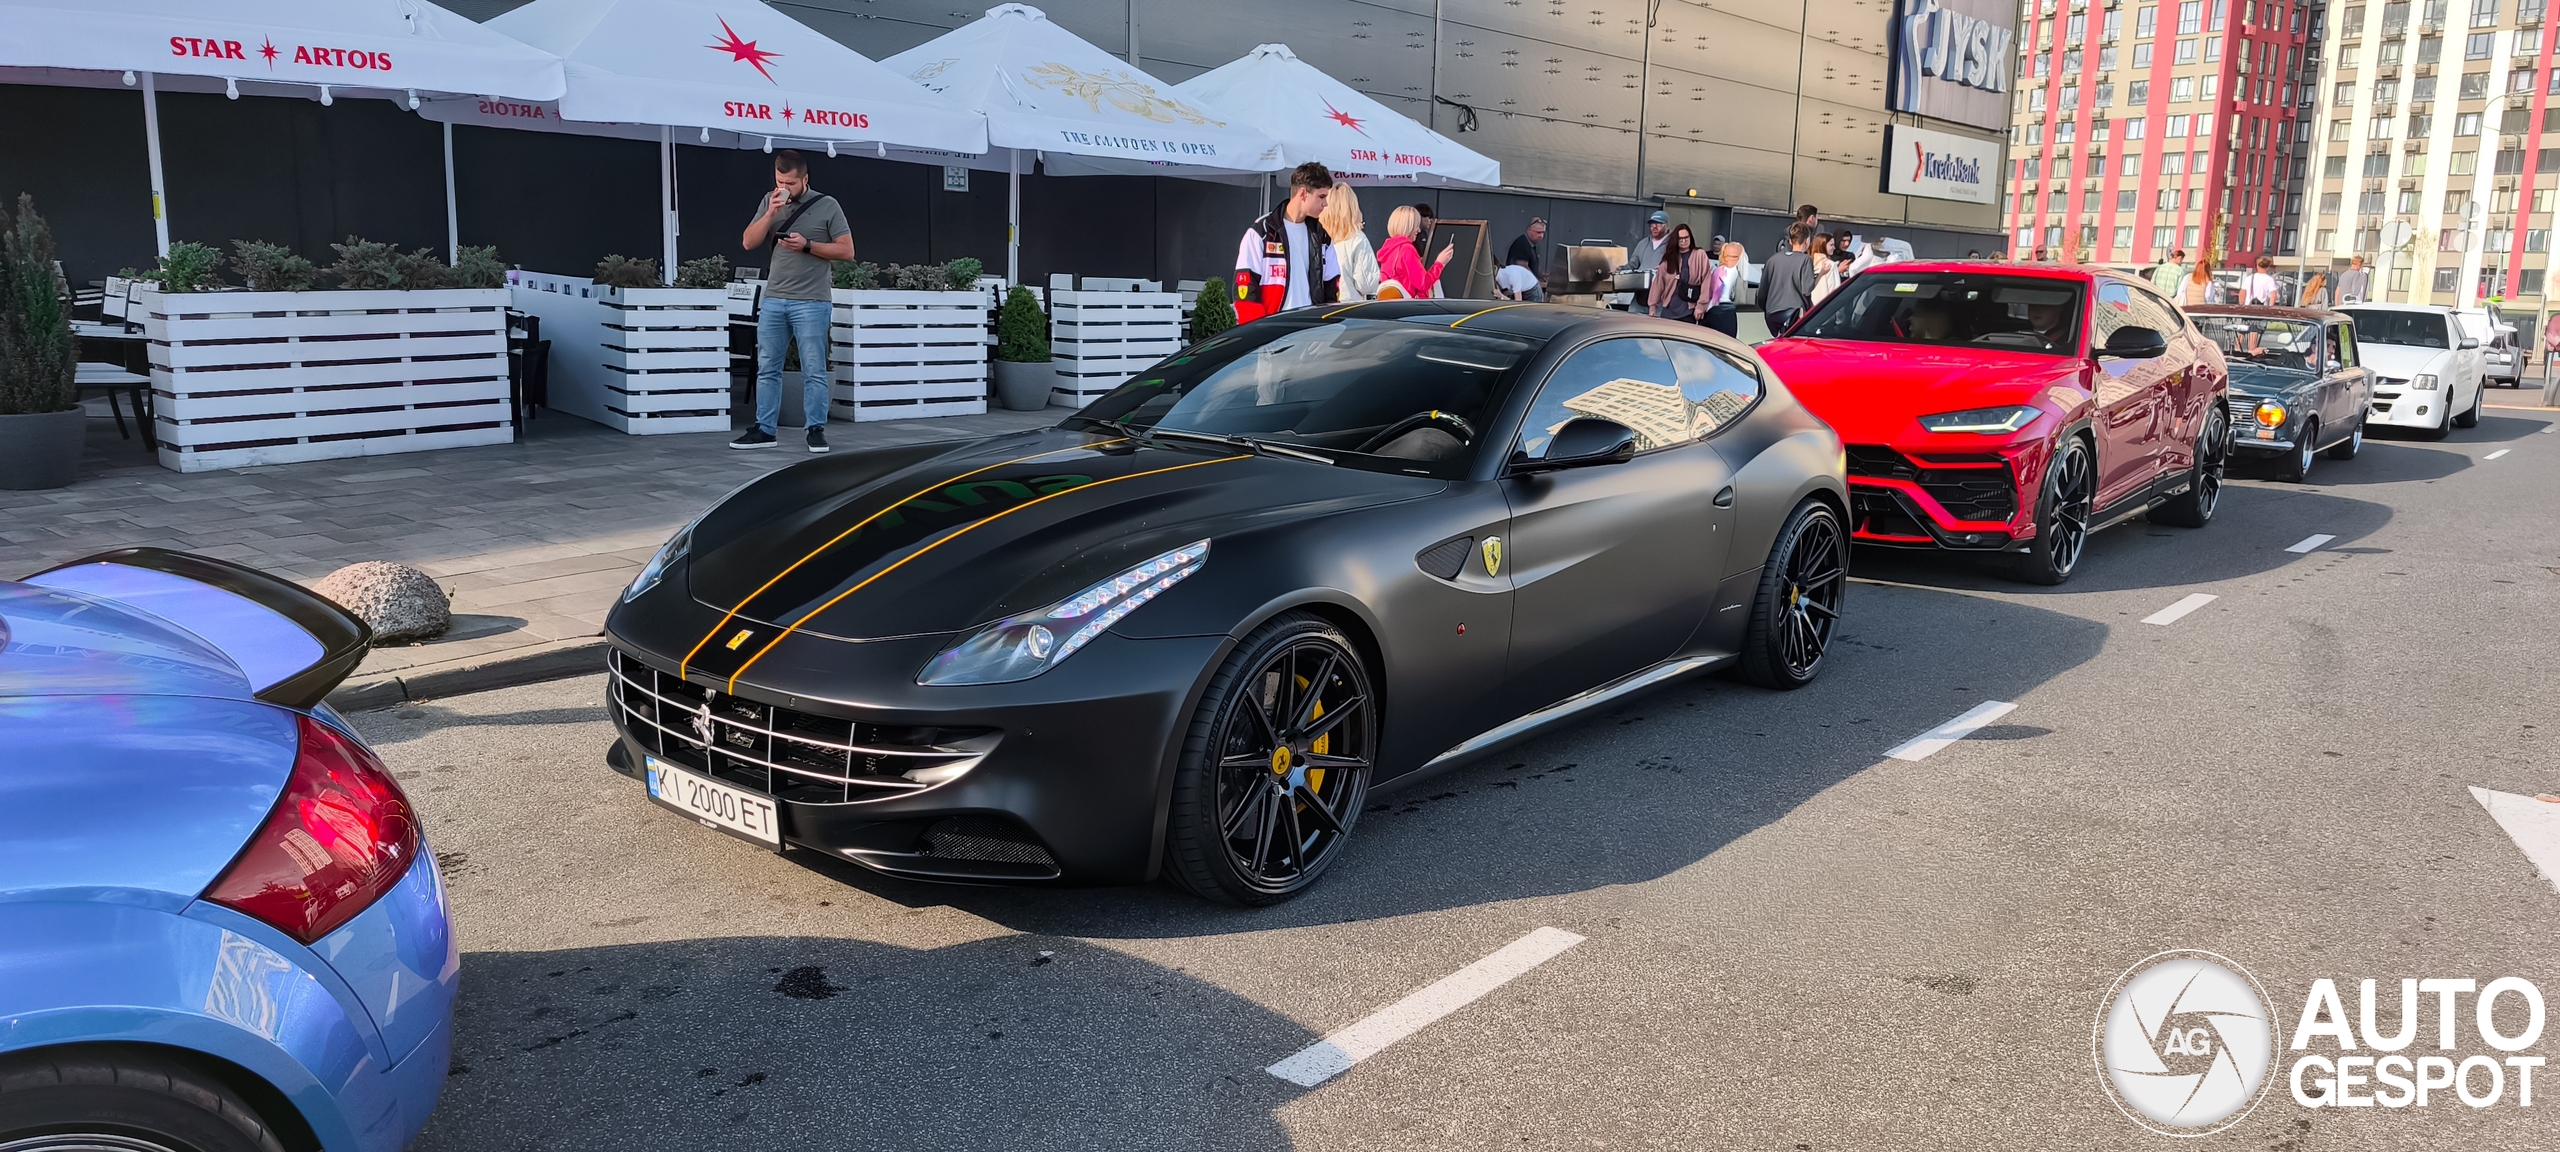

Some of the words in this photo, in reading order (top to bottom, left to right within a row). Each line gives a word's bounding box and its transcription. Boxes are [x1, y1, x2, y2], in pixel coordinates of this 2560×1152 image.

[170, 36, 246, 60] STAR
[293, 45, 392, 71] ARTOIS
[1924, 8, 2012, 93] JYSK
[723, 101, 772, 120] STAR
[803, 108, 869, 129] ARTOIS
[1060, 131, 1091, 145] THE
[1162, 141, 1176, 153] IS
[1181, 142, 1217, 156] OPEN
[1350, 149, 1378, 161] STAR
[1394, 153, 1432, 167] ARTOIS
[1925, 152, 1980, 184] KredoBank
[650, 780, 659, 791] UA
[656, 765, 681, 801] KI
[687, 779, 736, 822] 2000
[740, 796, 772, 835] ET
